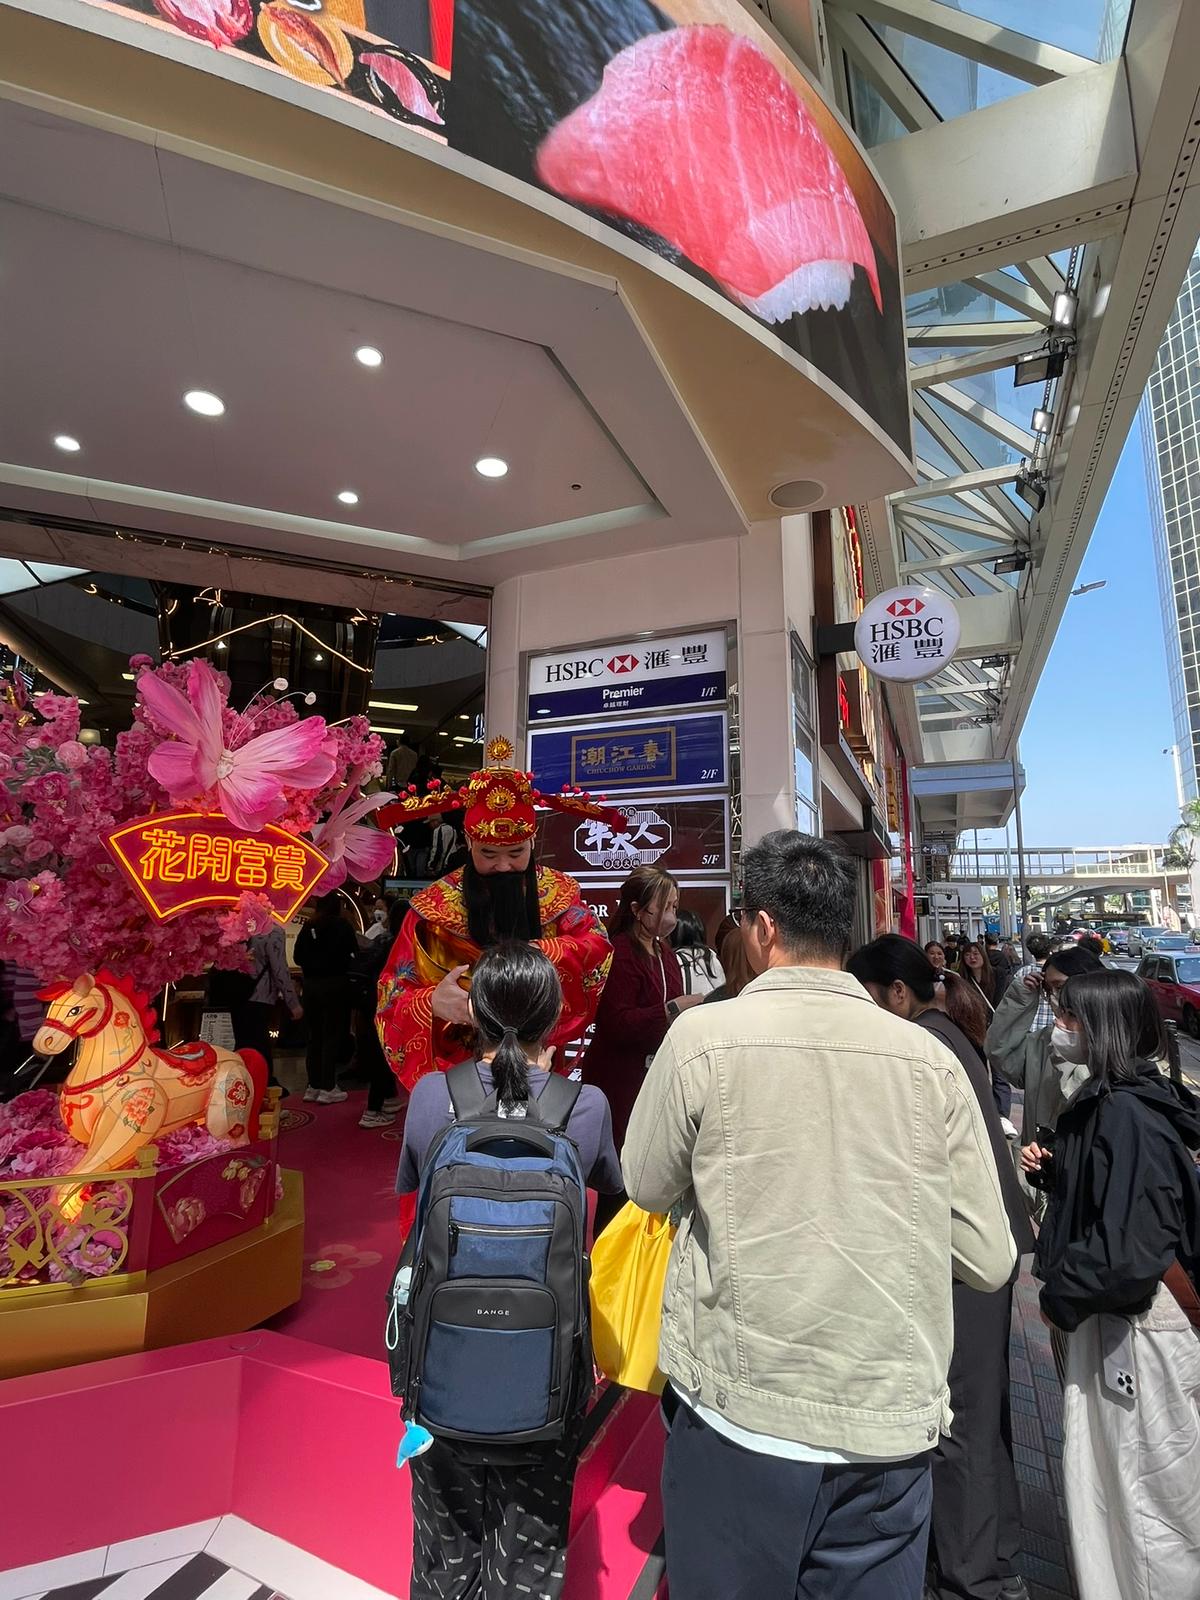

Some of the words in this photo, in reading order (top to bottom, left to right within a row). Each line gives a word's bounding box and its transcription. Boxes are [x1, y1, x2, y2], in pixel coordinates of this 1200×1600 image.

[869, 616, 944, 644] HSBC
[545, 658, 604, 684] HSBC
[602, 685, 644, 700] Premier
[700, 687, 718, 698] 1/F
[581, 739, 665, 767] 潮江春
[700, 769, 718, 779] 2/F
[584, 821, 664, 857] 牛大人
[139, 828, 307, 891] 花開富貴
[701, 854, 720, 865] 5/F
[476, 1308, 510, 1316] BANGE
